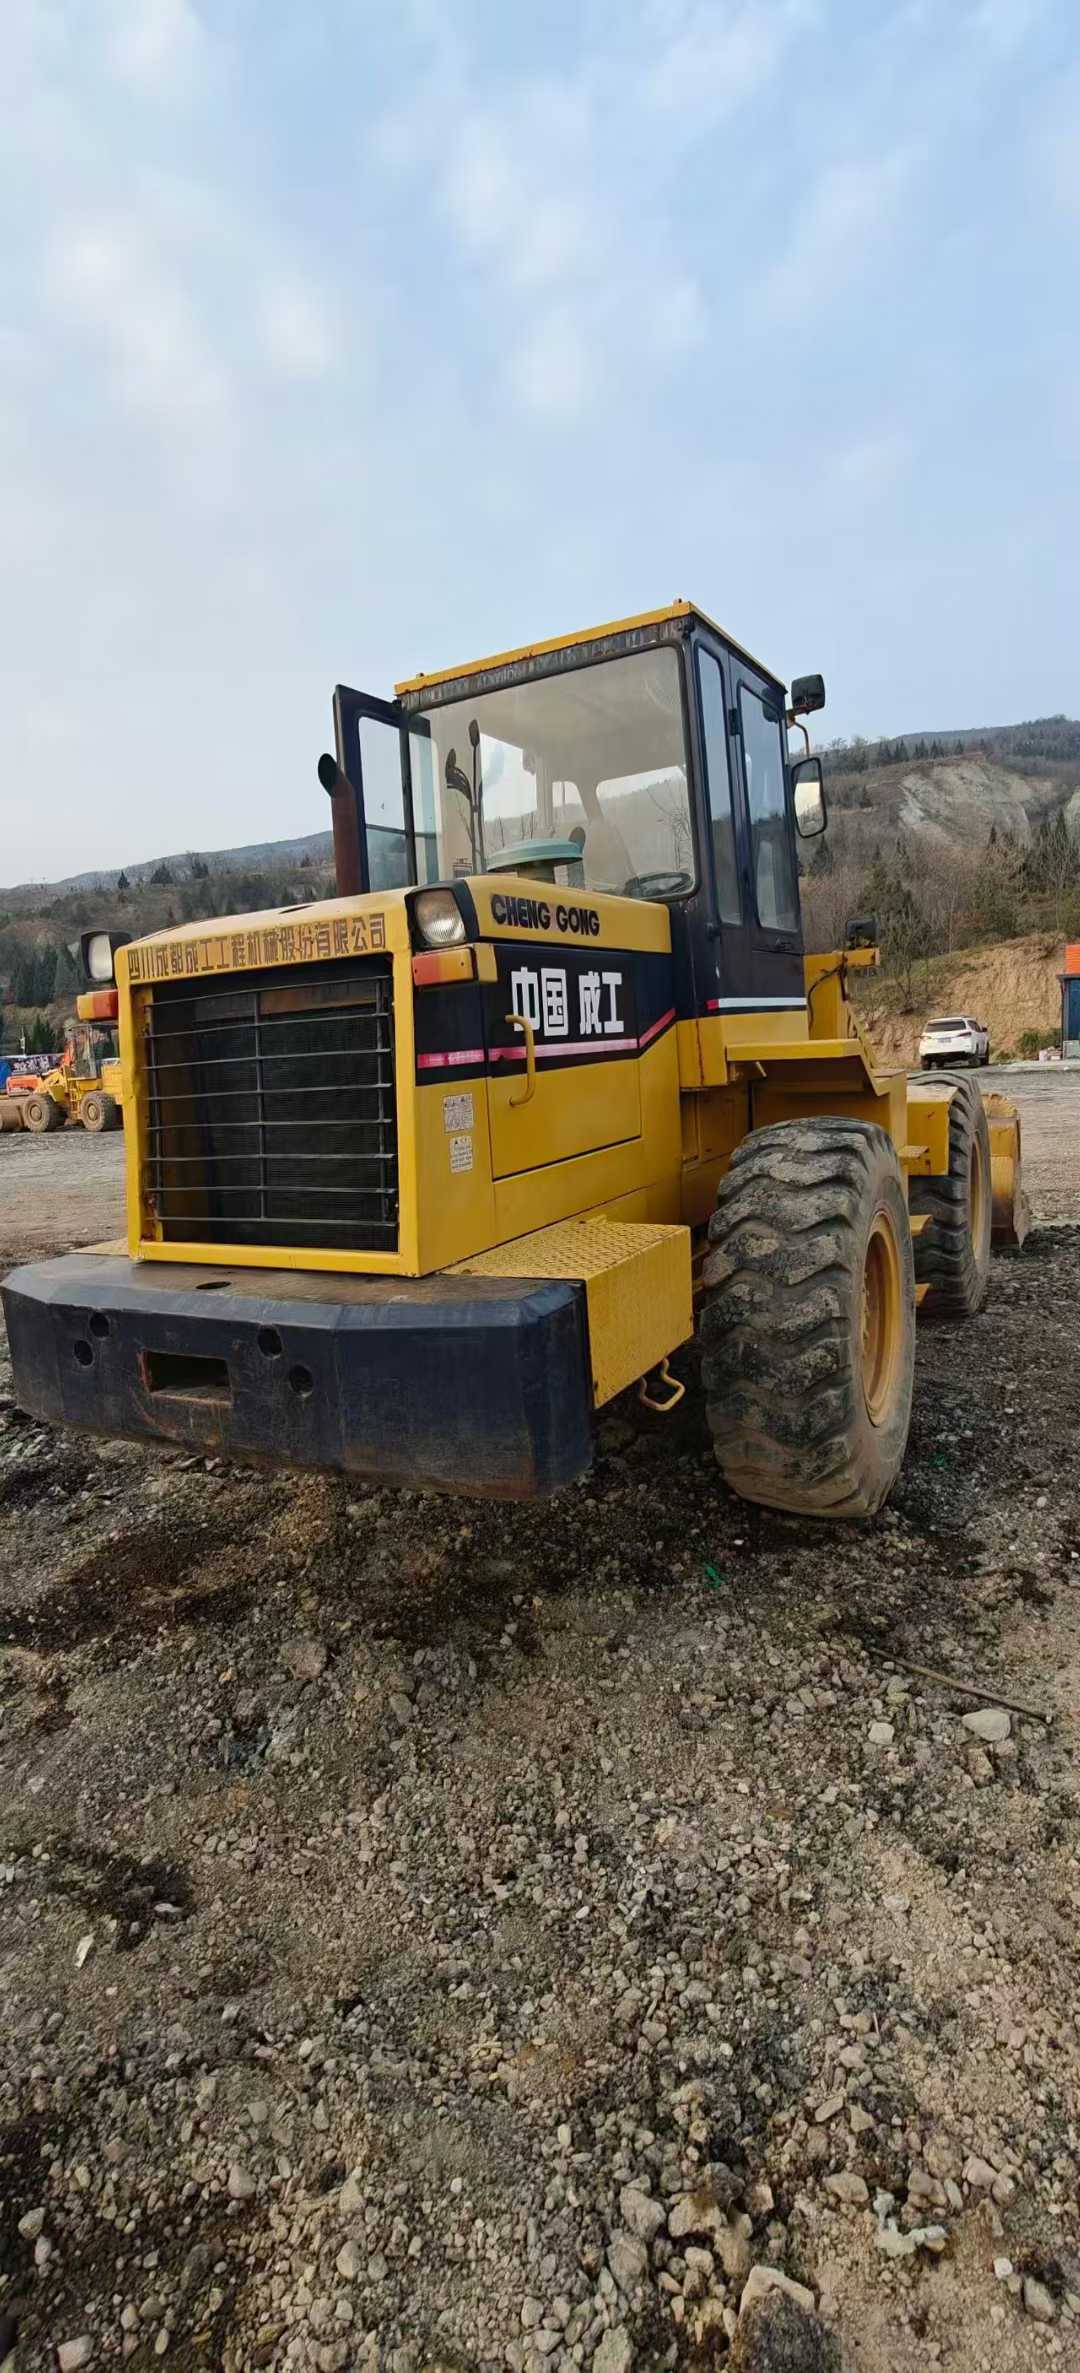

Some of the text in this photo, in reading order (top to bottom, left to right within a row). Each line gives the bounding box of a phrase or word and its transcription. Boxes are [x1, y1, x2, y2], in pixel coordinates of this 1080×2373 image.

[128, 913, 386, 980] 四川成都成工工程机械股份有限公司
[491, 894, 600, 936] CHENG GONG
[511, 966, 624, 1036] 中国 成工
